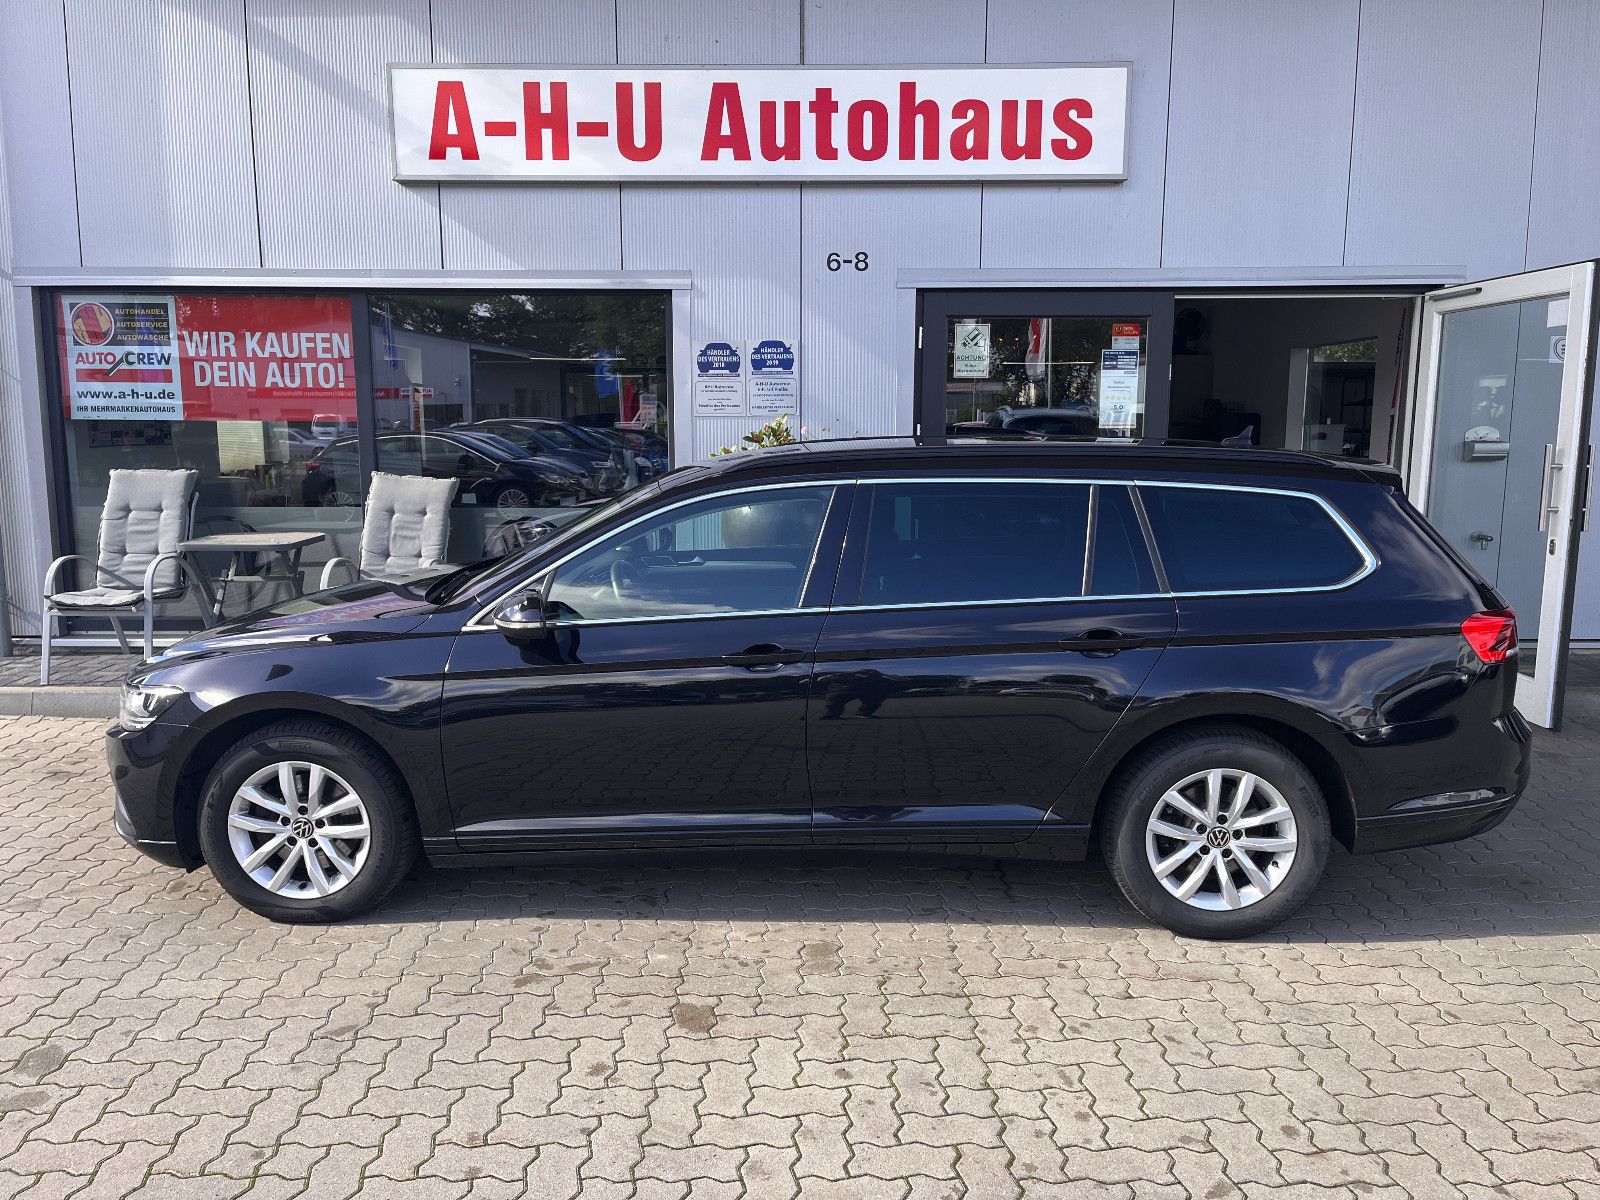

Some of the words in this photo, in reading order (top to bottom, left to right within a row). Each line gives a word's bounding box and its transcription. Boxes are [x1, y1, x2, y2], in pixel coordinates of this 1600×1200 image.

[428, 81, 662, 161] A-H-U
[700, 81, 1094, 162] Autohaus
[826, 251, 870, 272] 6-8
[114, 308, 166, 316] AUTOHANDEL
[115, 321, 169, 329] AUTOSERVICE
[183, 331, 237, 358] WIR
[245, 331, 350, 360] KAUFEN
[75, 351, 117, 365] AUTO
[123, 350, 171, 366] CREW
[193, 361, 257, 388] DEIN
[265, 361, 346, 389] AUTO!
[77, 388, 176, 400] www.a-h-u.de
[76, 405, 89, 413] IHR
[90, 405, 176, 414] MEHRMARKENAUTOHAUS
